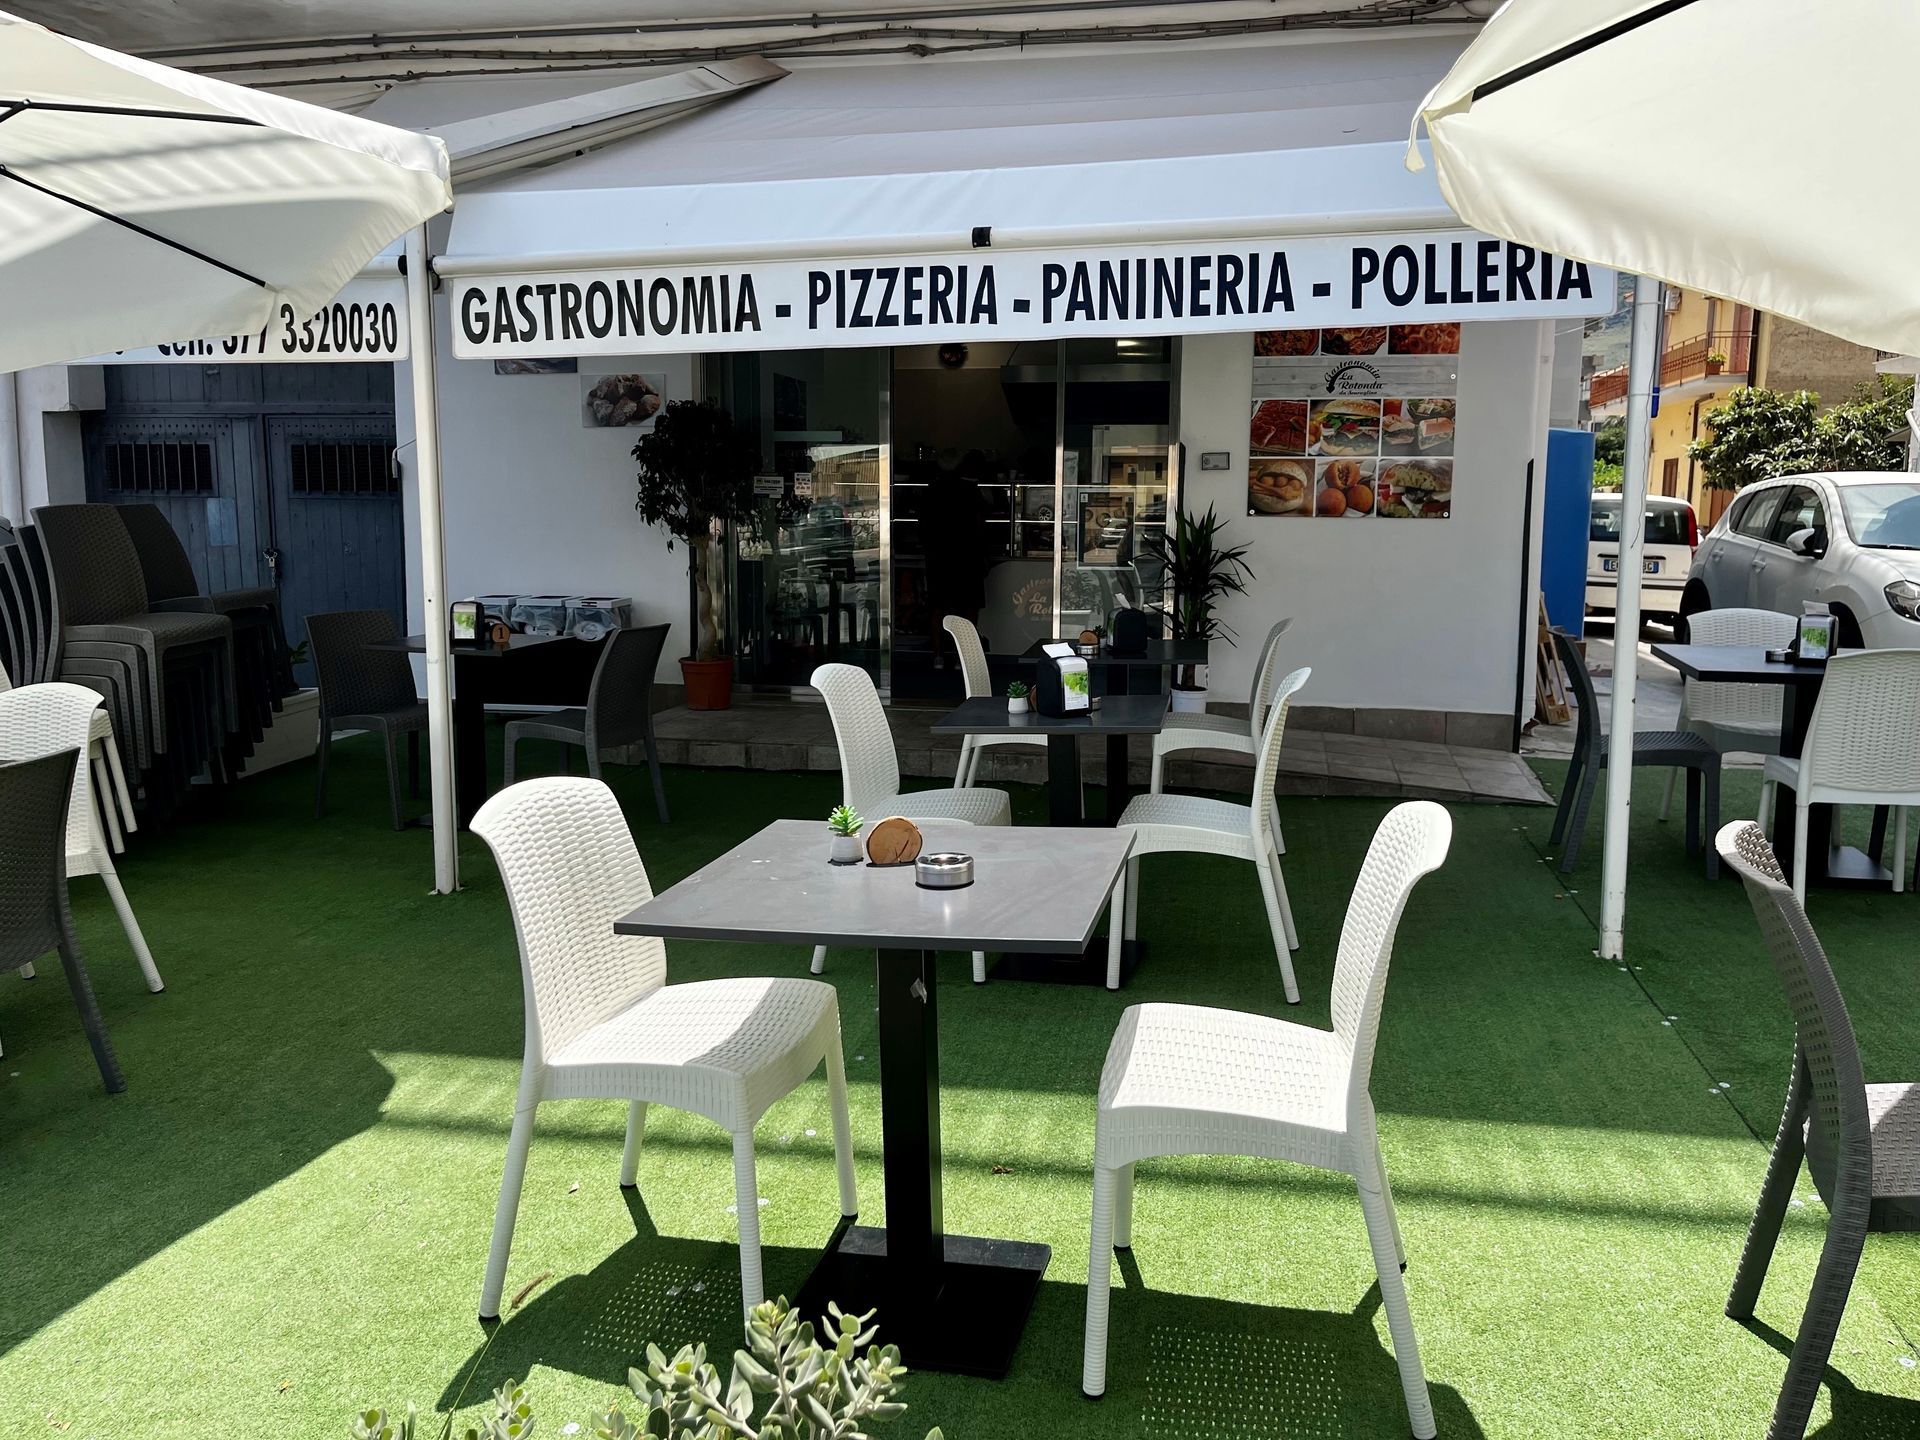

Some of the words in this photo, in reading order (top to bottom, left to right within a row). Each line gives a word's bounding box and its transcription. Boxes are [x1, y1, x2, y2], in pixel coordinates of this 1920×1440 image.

[461, 273, 761, 344] GASTRONOMIA
[775, 304, 791, 318] -
[808, 264, 998, 330] PIZZERIA
[1013, 298, 1030, 313] -
[1043, 251, 1295, 324] PANINERIA
[1312, 282, 1331, 297] -
[1351, 240, 1593, 309] POLLERIA
[1325, 359, 1381, 382] Gastronomia
[1339, 372, 1353, 380] La
[1339, 381, 1383, 389] Rotonda
